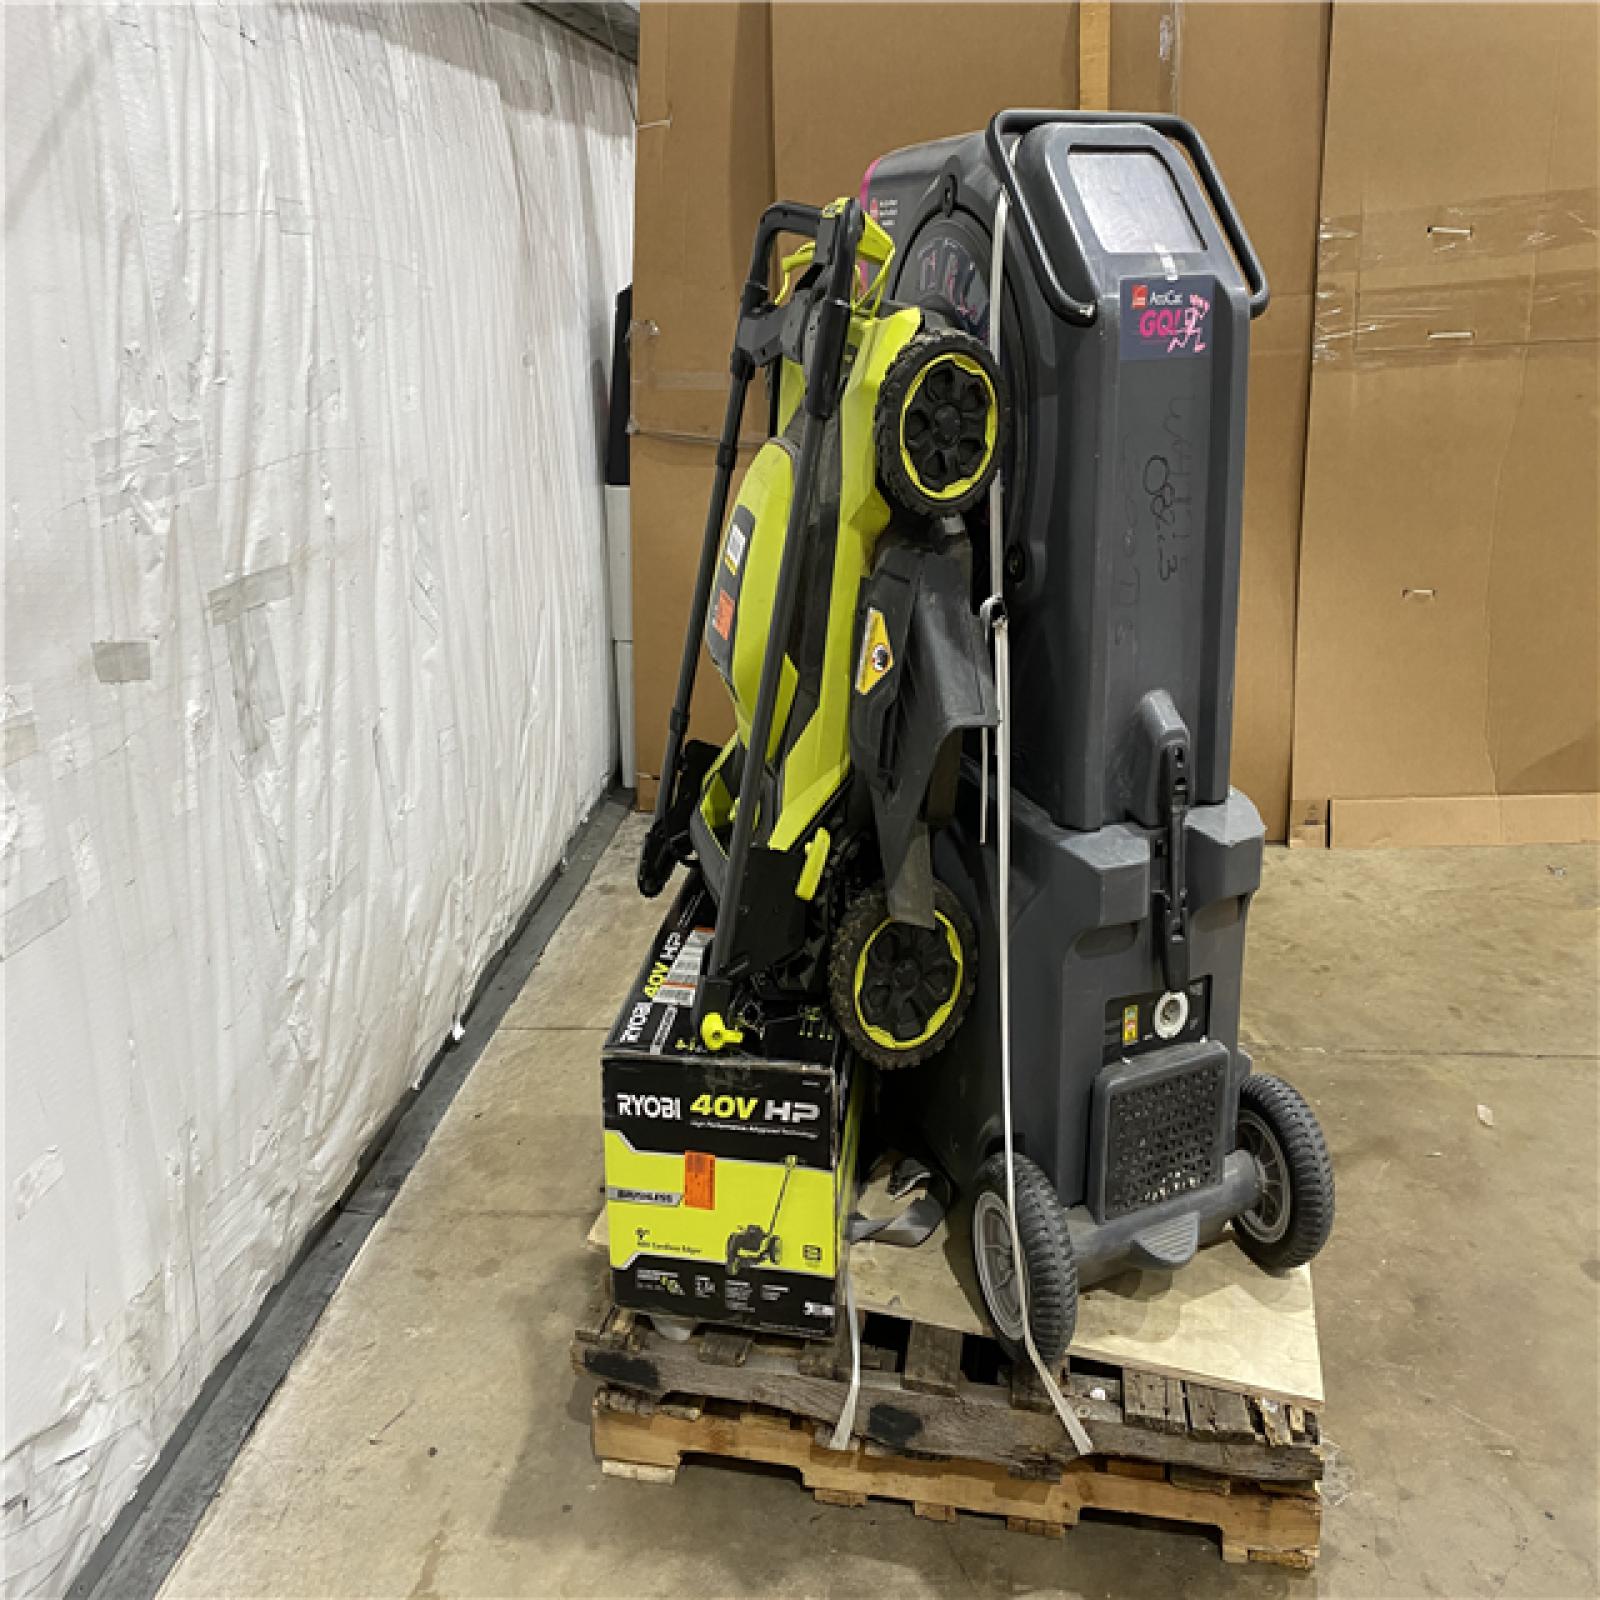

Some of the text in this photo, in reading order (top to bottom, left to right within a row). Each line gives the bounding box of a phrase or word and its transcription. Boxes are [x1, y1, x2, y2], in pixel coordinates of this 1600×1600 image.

[616, 1091, 821, 1124] RYOBI 40V HP
